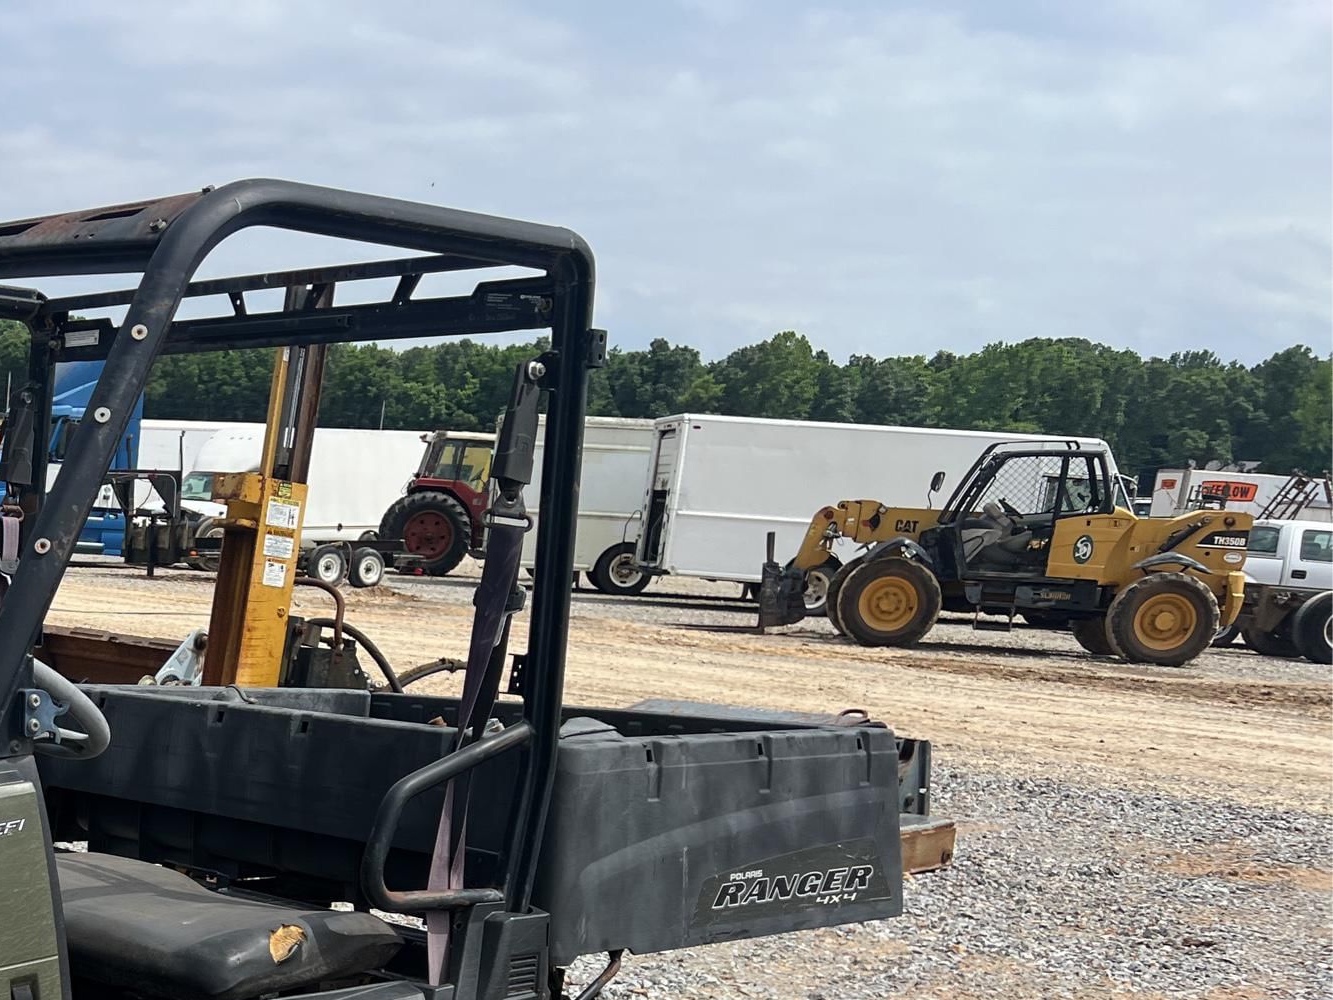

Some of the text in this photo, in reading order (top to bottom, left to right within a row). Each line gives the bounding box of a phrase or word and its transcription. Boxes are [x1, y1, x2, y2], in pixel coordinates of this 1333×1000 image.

[895, 519, 919, 533] CAT
[1213, 535, 1246, 546] TH350B
[730, 869, 763, 881] POLARIS
[712, 864, 874, 909] RANGER
